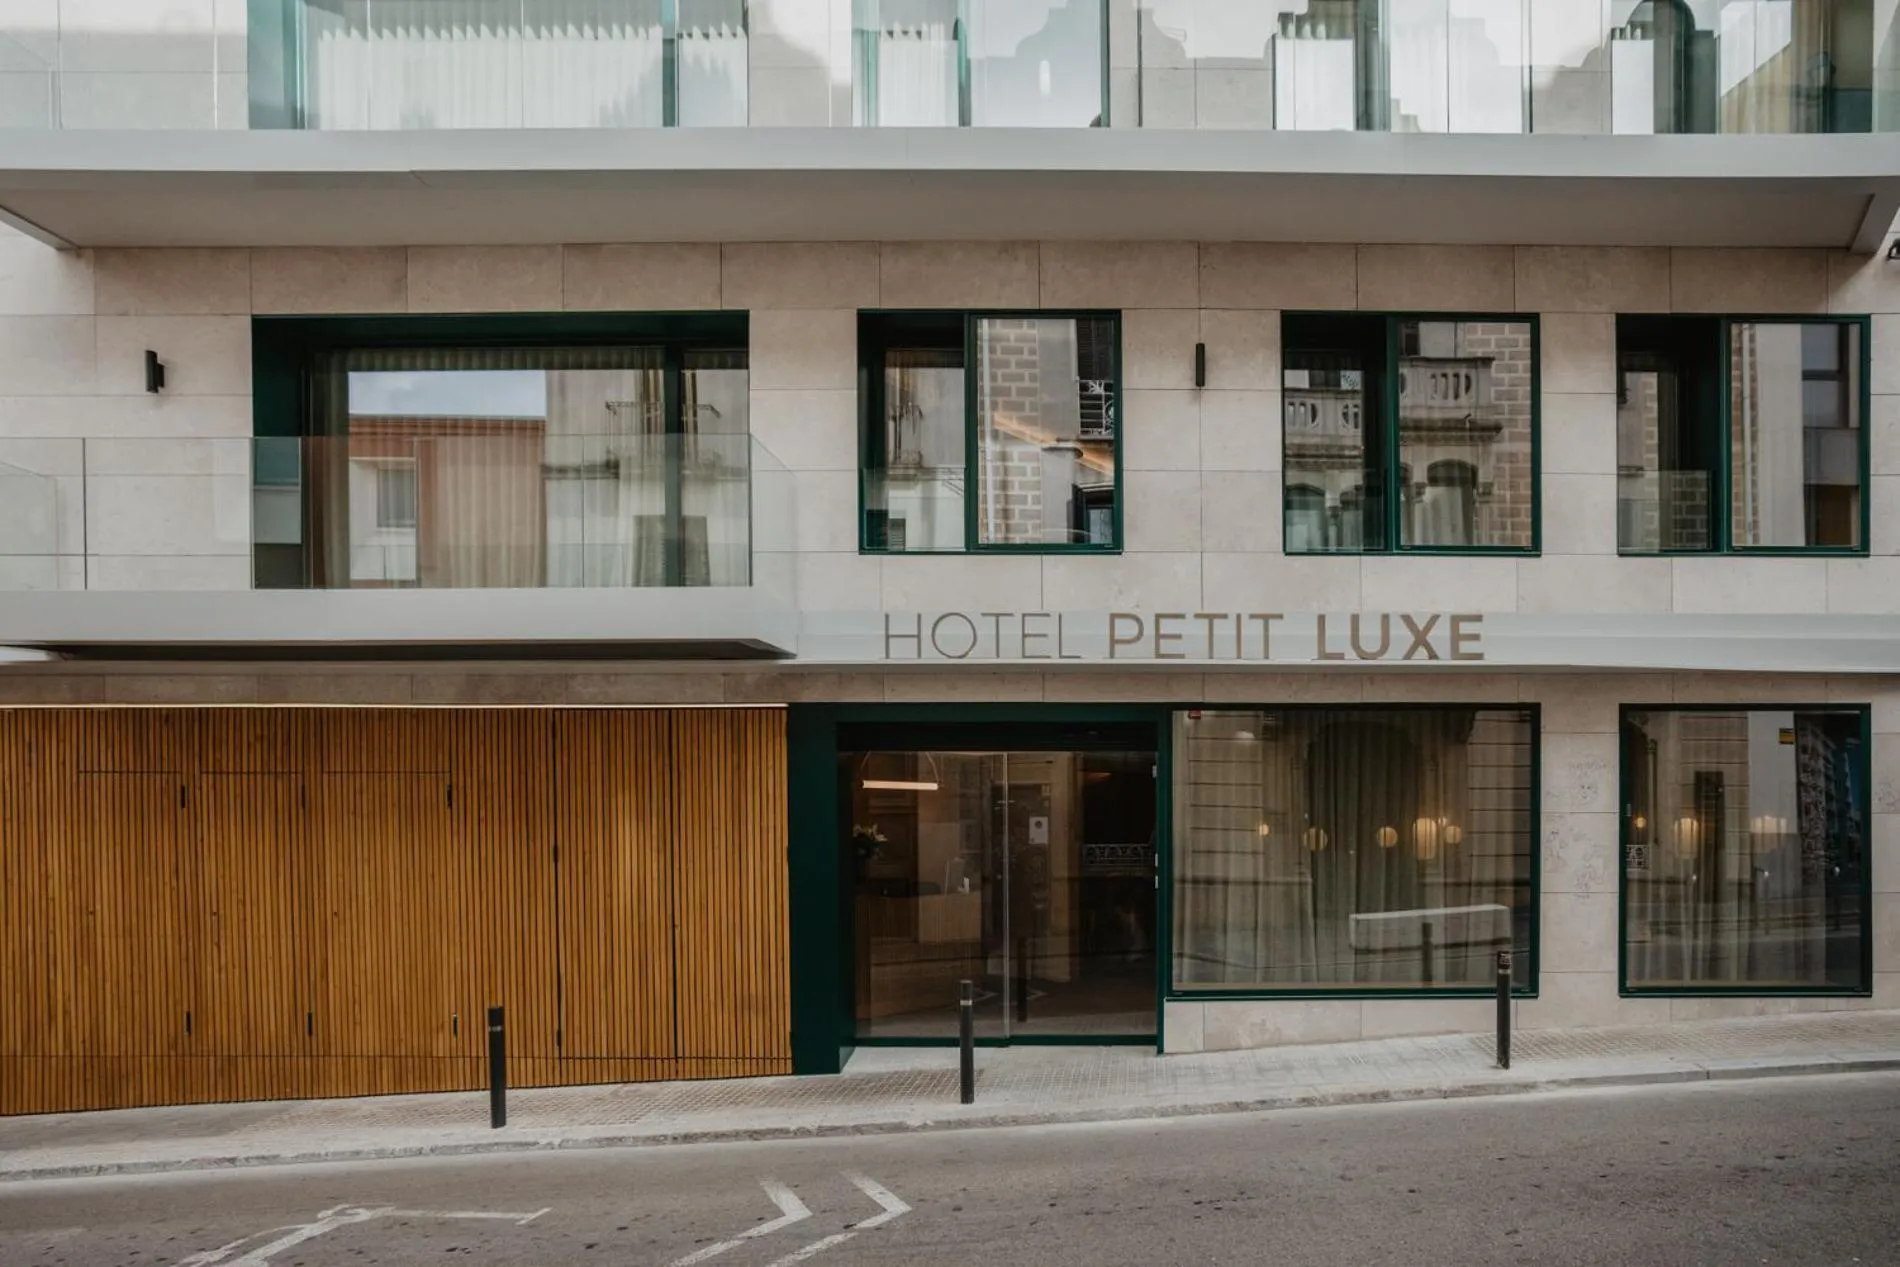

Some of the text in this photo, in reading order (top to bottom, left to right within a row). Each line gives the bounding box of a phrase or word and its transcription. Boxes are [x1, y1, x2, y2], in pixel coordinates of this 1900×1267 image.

[884, 612, 1485, 660] HOTEL PETIT LUXE
